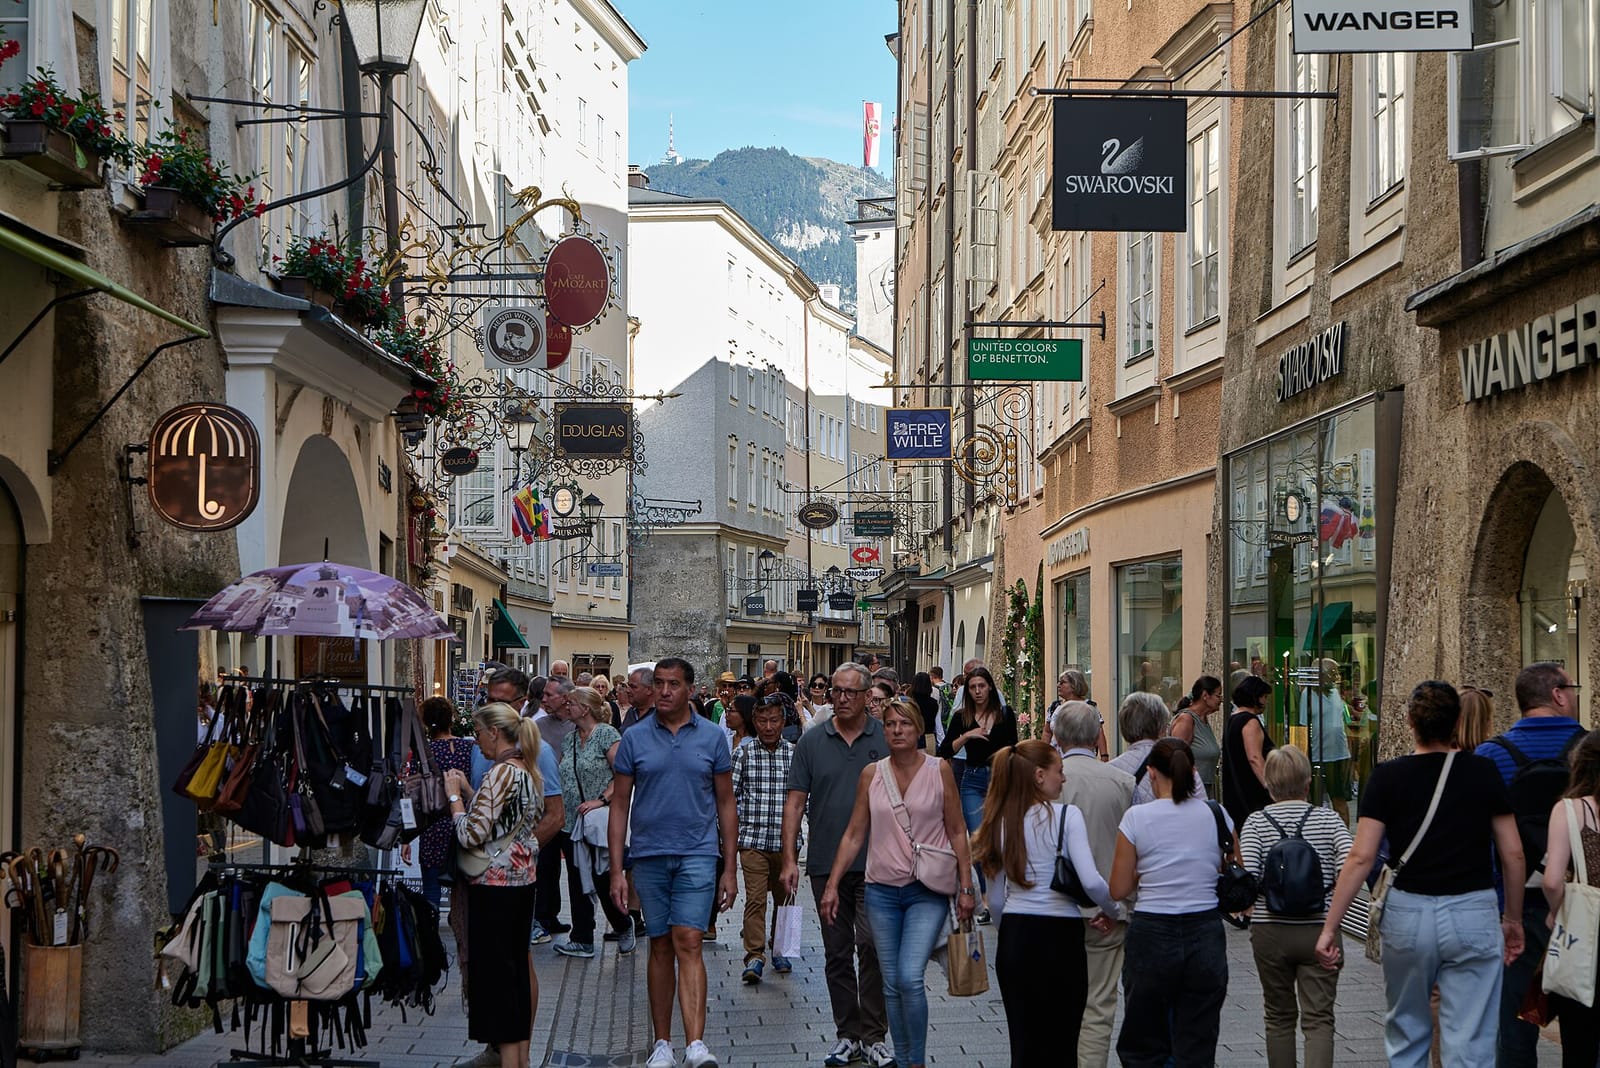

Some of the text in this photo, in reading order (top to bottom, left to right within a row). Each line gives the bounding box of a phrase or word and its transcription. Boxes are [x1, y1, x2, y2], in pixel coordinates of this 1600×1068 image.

[1303, 10, 1459, 32] WANGER
[1065, 174, 1174, 194] SWAROVSKI
[557, 278, 607, 289] MOZART
[492, 312, 537, 330] HENRI WILLIG
[972, 342, 1058, 353] UNITED COLORS
[1457, 293, 1600, 403] WANGER
[972, 353, 1049, 364] OF BENETTON.
[1276, 320, 1344, 403] SWAROVSKI
[562, 424, 625, 438] DOUGLAS
[908, 423, 947, 436] FREY
[893, 435, 944, 448] WILLE
[444, 457, 477, 466] DOUGLAS
